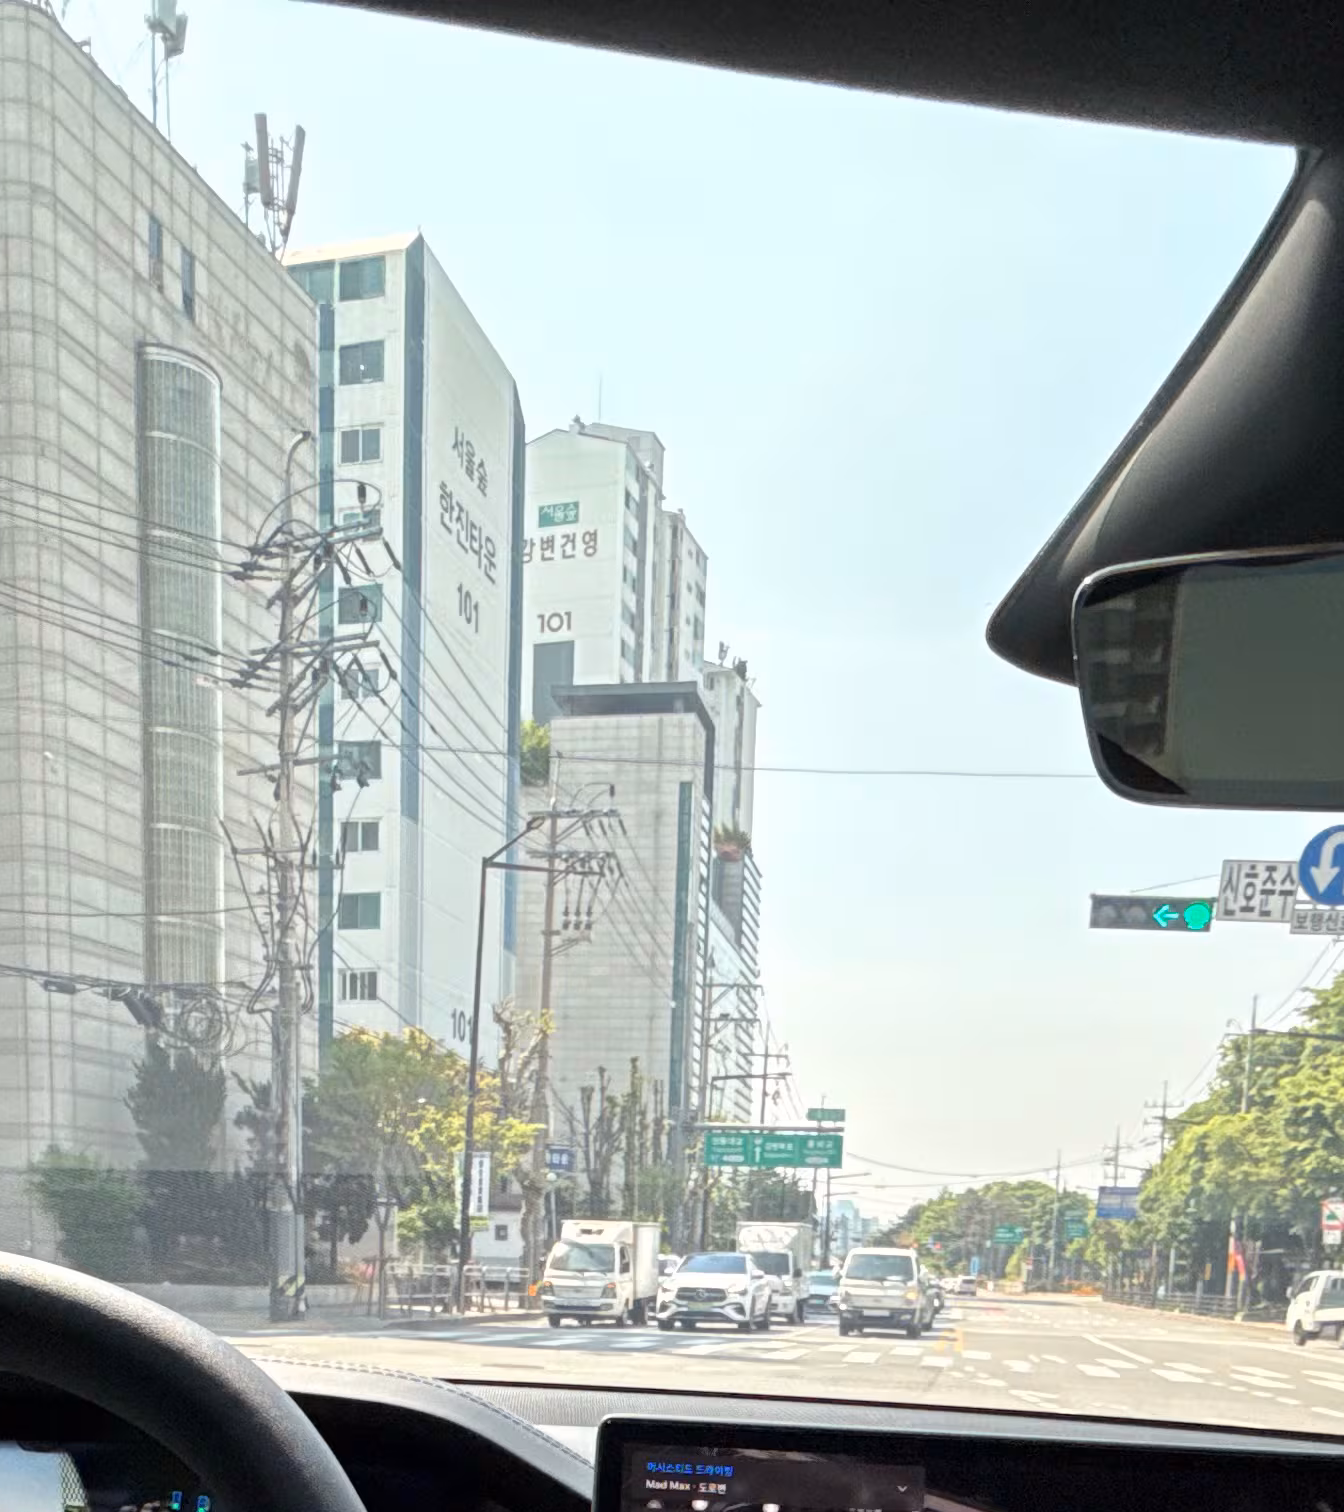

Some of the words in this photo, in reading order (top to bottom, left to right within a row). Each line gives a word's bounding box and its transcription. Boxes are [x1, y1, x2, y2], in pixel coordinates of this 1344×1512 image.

[451, 426, 488, 497] 서울숲
[541, 503, 578, 524] 서울숲
[439, 480, 497, 585] 한진타운
[457, 582, 479, 634] 101
[537, 611, 573, 634] 101
[1222, 863, 1297, 920] 신호준수
[645, 1479, 668, 1491] Mad
[669, 1480, 691, 1491] Max
[695, 1464, 733, 1477] 드라이빙
